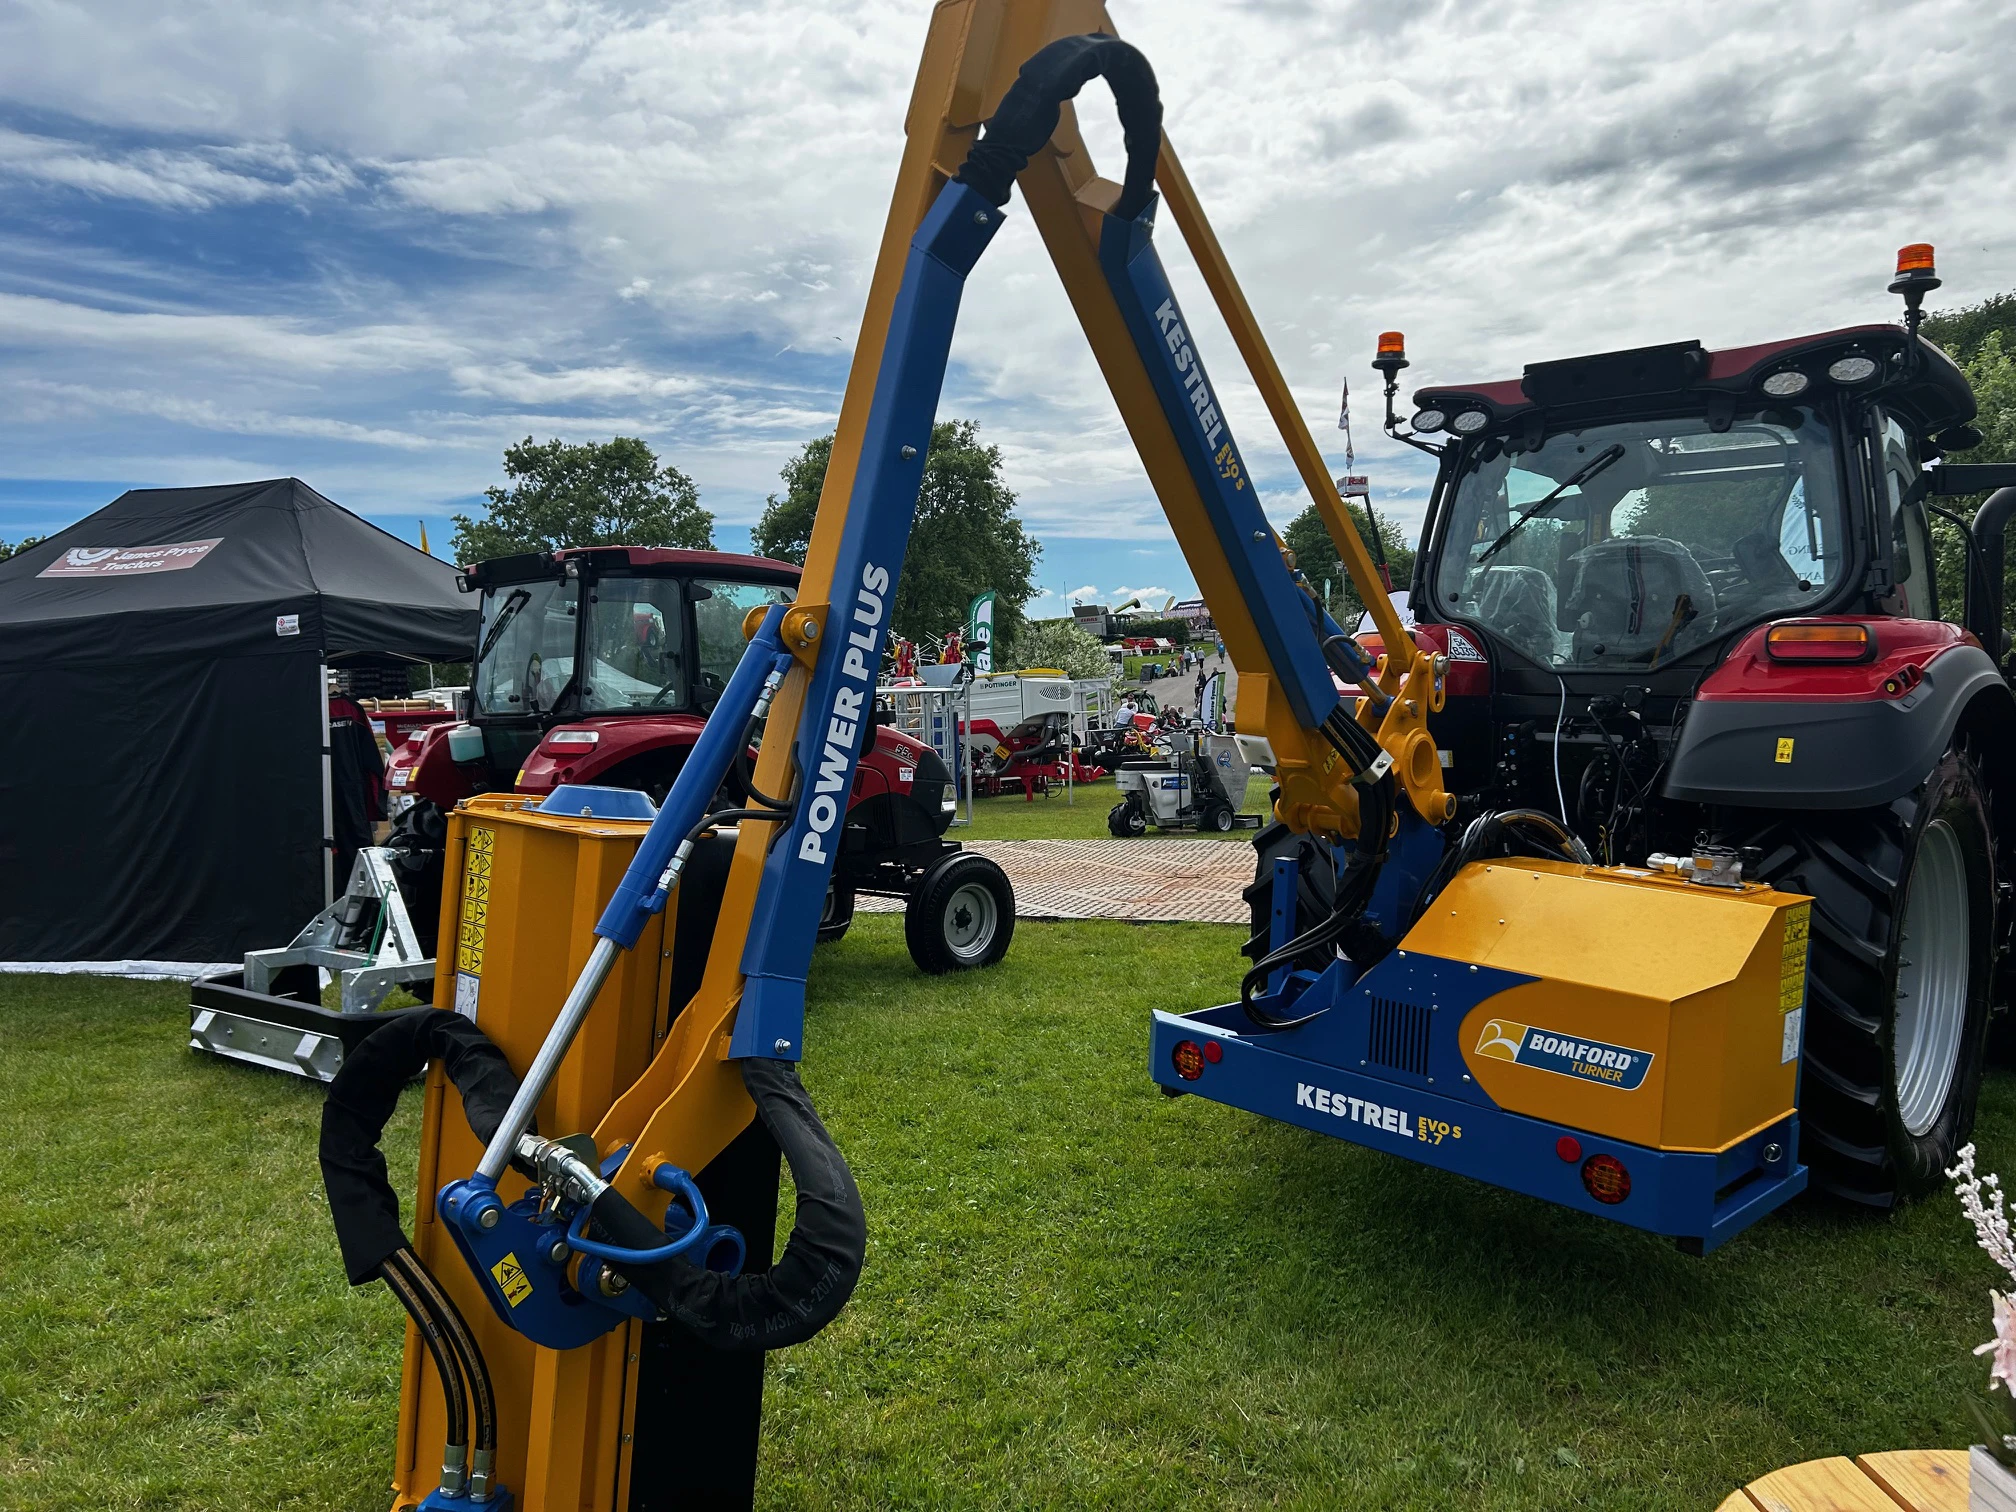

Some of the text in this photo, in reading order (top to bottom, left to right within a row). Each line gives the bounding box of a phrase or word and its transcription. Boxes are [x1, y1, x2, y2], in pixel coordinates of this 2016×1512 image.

[1155, 298, 1223, 451] KESTREL
[1215, 452, 1231, 479] 5.7
[113, 544, 210, 561] James Pryce
[101, 559, 165, 571] Tractors
[798, 561, 890, 865] POWER PLUS
[1572, 1060, 1624, 1083] TURNER
[1296, 1082, 1414, 1138] KESTREL
[1418, 1116, 1450, 1136] EVO
[1418, 1129, 1443, 1146] 5.7
